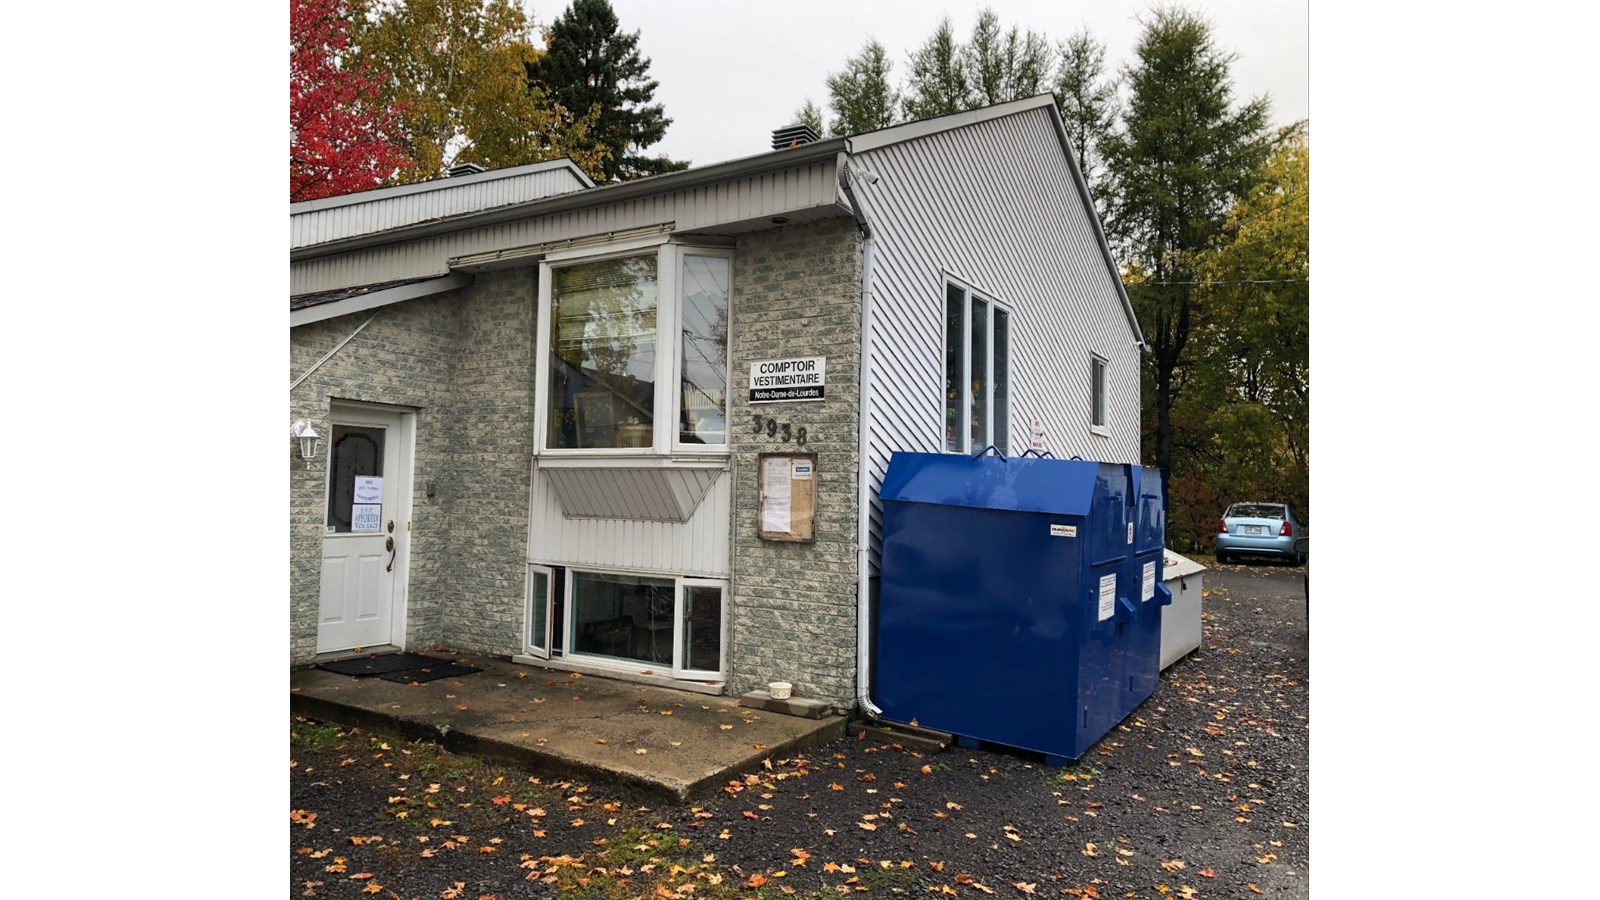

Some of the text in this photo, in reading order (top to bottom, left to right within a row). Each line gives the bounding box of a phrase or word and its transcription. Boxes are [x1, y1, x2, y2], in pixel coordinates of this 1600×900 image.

[760, 360, 815, 374] COMPTOIR
[753, 373, 820, 386] VESTIMENTAIRE
[754, 388, 819, 399] Notre-Dame-de-Lourdes
[752, 415, 807, 447] 3938
